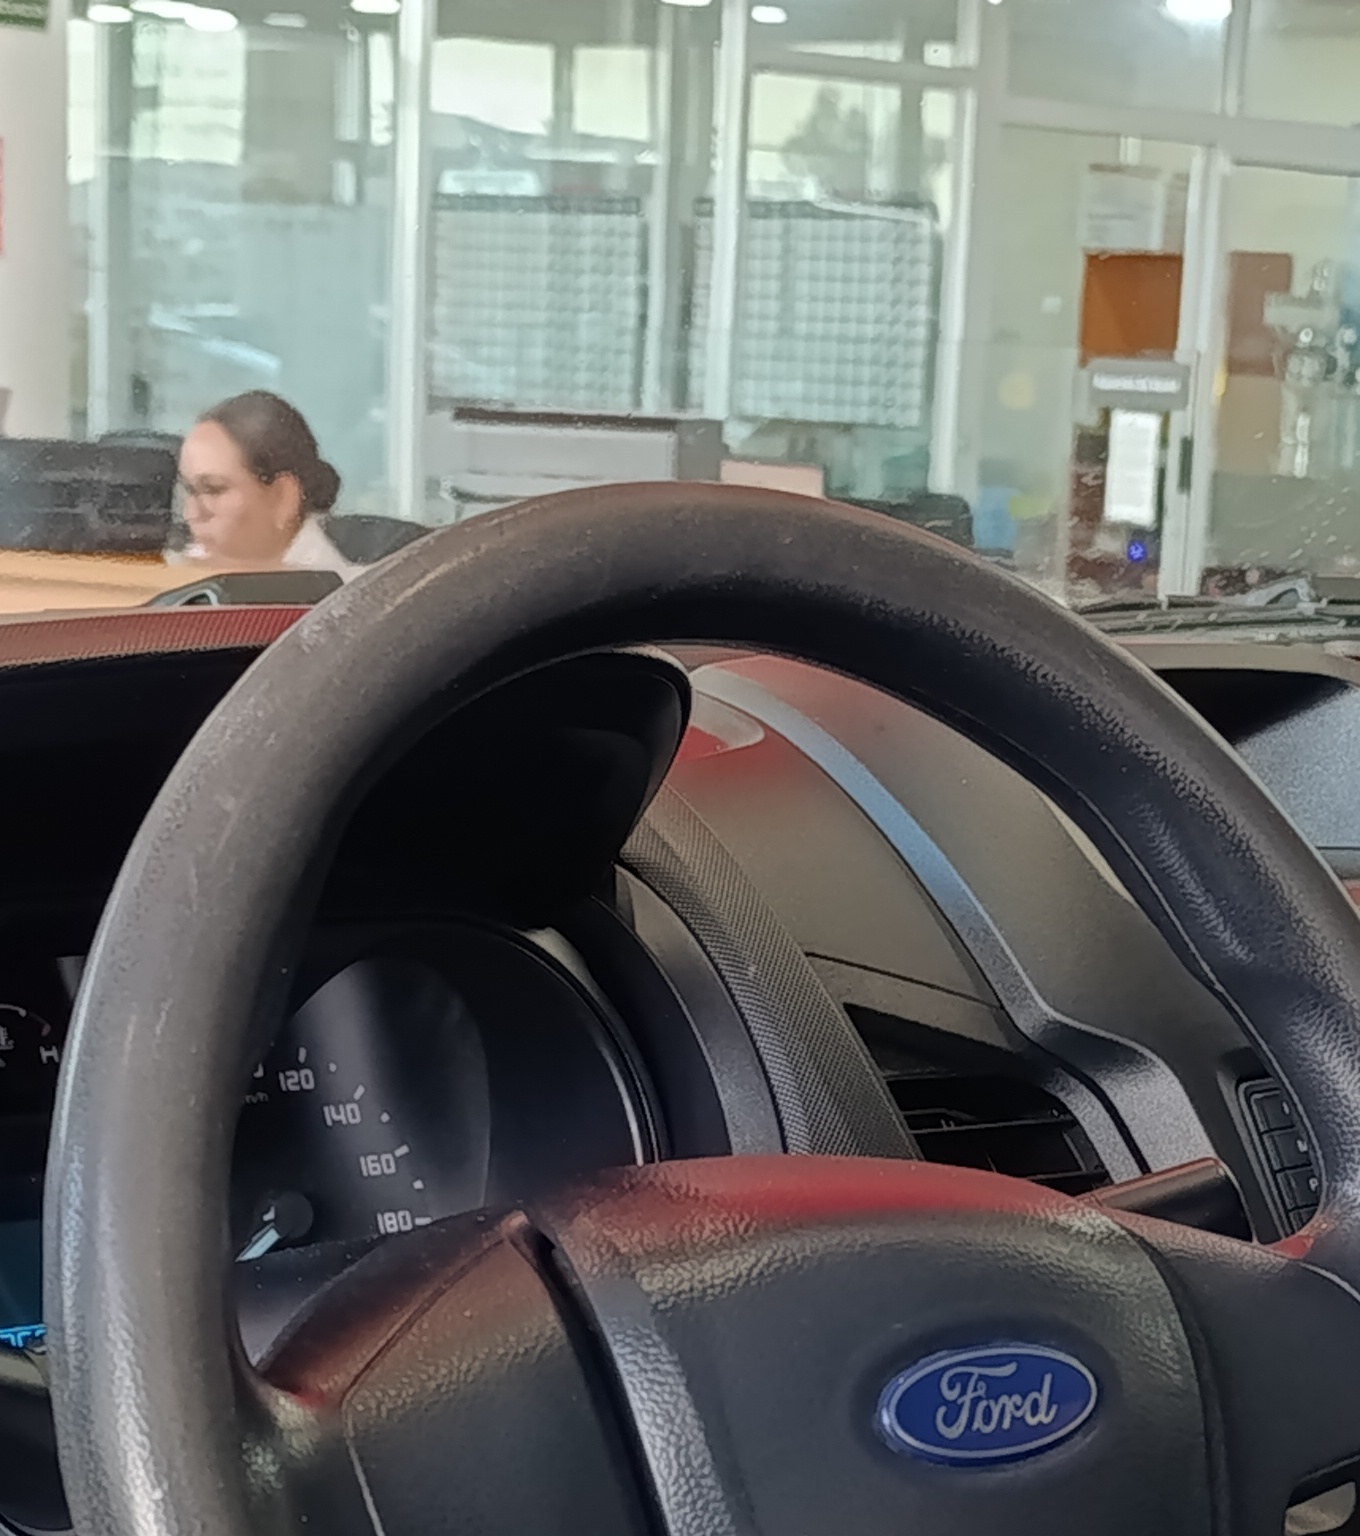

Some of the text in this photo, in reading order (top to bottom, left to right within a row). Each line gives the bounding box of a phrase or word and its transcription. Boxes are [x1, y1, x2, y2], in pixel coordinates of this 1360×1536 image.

[278, 1068, 315, 1092] 120
[323, 1102, 362, 1127] 140
[359, 1153, 397, 1177] 160
[377, 1210, 413, 1235] 180
[935, 1361, 1059, 1441] Ford
